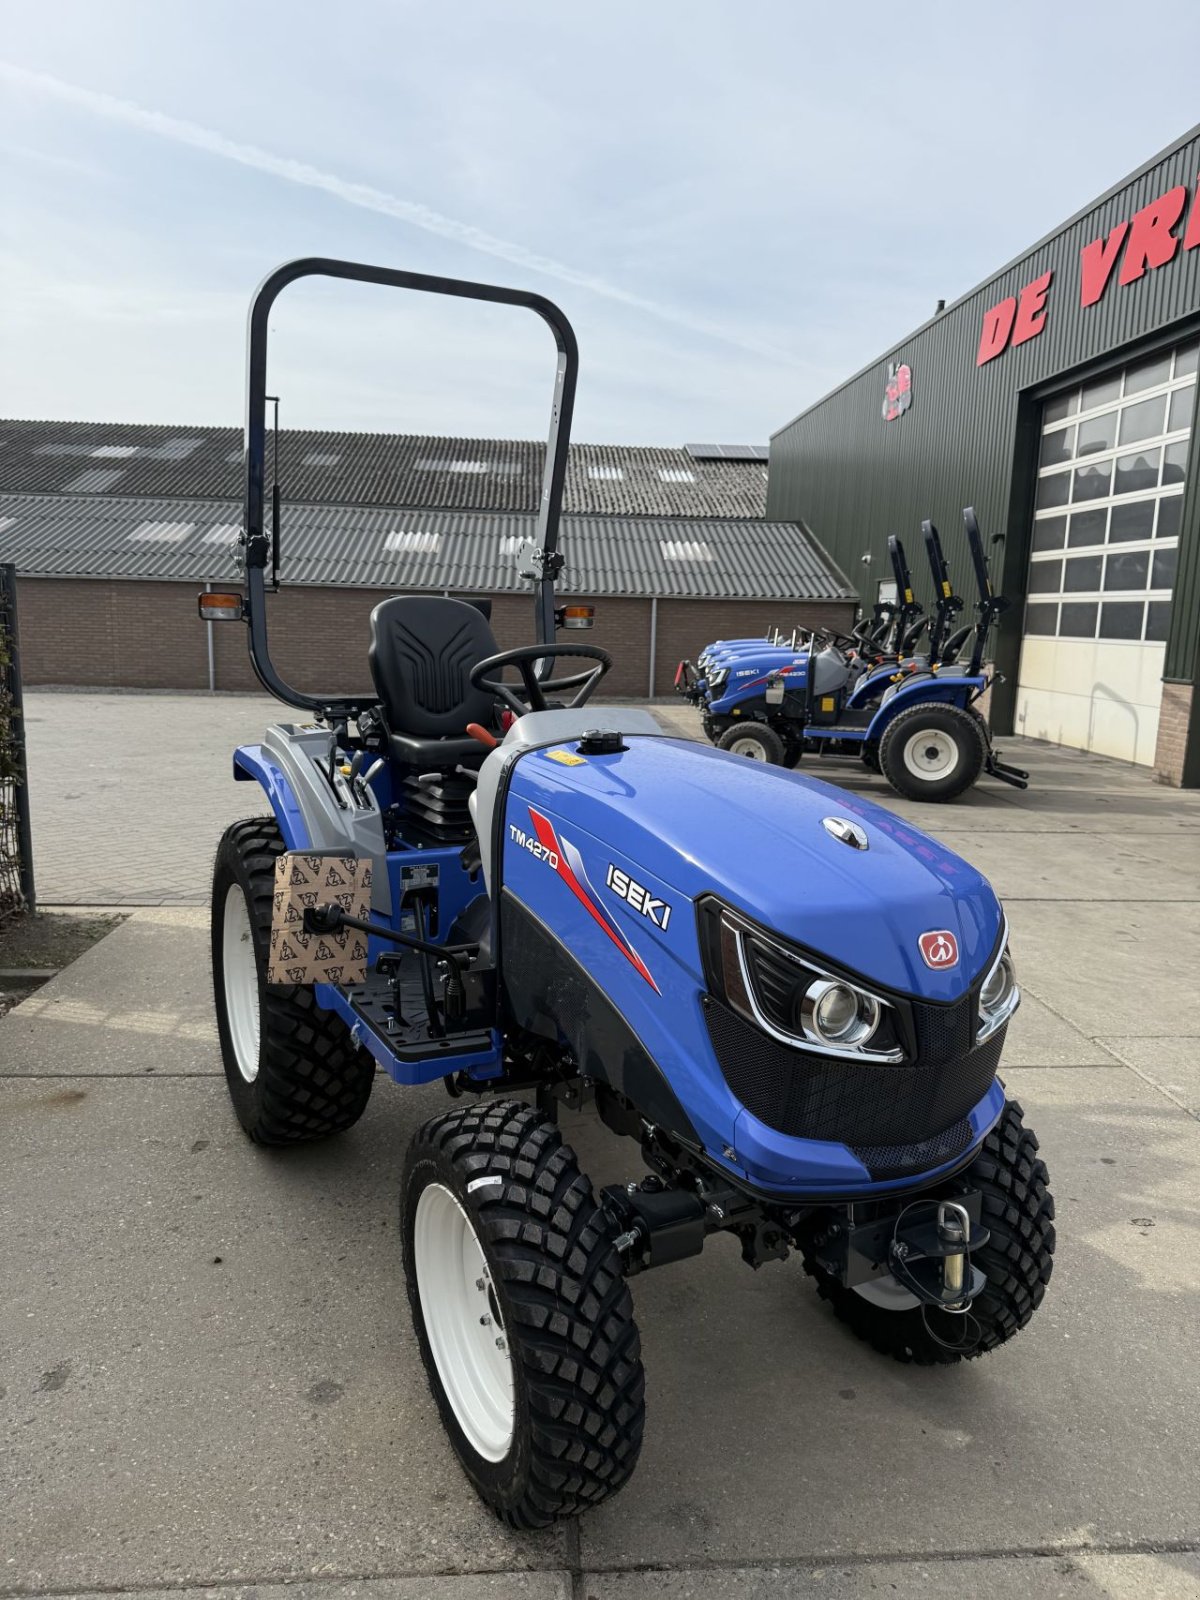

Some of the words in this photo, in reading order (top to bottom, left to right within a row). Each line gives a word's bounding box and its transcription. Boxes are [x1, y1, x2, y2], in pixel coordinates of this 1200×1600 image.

[976, 270, 1053, 367] DE
[736, 669, 759, 677] ISEKI
[509, 824, 559, 870] TM4270
[605, 862, 672, 932] ISEKI
